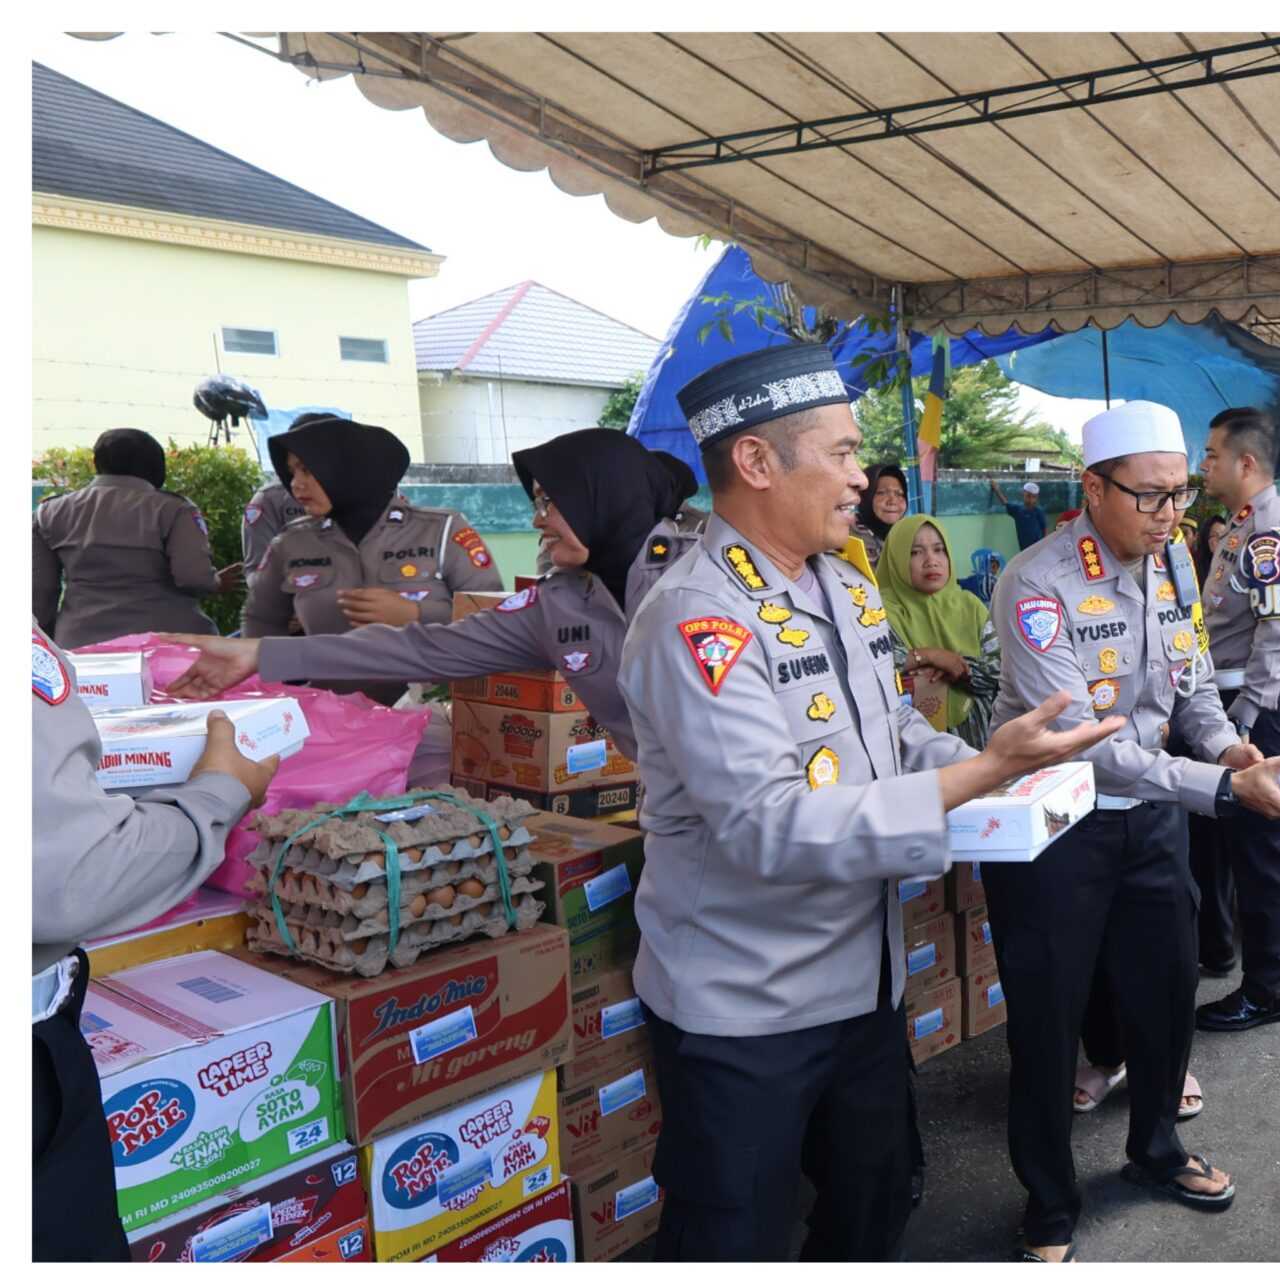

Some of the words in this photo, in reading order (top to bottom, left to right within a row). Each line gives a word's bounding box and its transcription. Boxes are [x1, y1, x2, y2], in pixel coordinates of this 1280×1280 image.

[383, 545, 435, 562] POLRI
[557, 624, 591, 644] UNI
[684, 620, 709, 634] OPS
[711, 620, 749, 638] POLRI
[1076, 621, 1128, 643] YUSEP
[124, 751, 173, 769] MINANG
[599, 789, 629, 806] 20240
[198, 1041, 273, 1090] LAPEER
[445, 1028, 537, 1079] goreng
[213, 1063, 271, 1098] TIME
[256, 1088, 301, 1118] SOTO
[258, 1099, 305, 1131] AYAM
[106, 1089, 162, 1144] POP
[121, 1098, 187, 1157] MIE
[458, 1099, 514, 1143] LAPEER
[294, 1125, 322, 1147] 24
[470, 1118, 512, 1150] TIME
[184, 1135, 231, 1168] ENAK
[503, 1142, 532, 1167] KARI
[334, 1161, 357, 1184] 12
[390, 1143, 434, 1191] POP
[503, 1153, 537, 1181] AYAM
[527, 1172, 549, 1190] 24
[135, 1209, 148, 1221] RI
[150, 1199, 169, 1214] MD
[340, 1235, 363, 1256] 12
